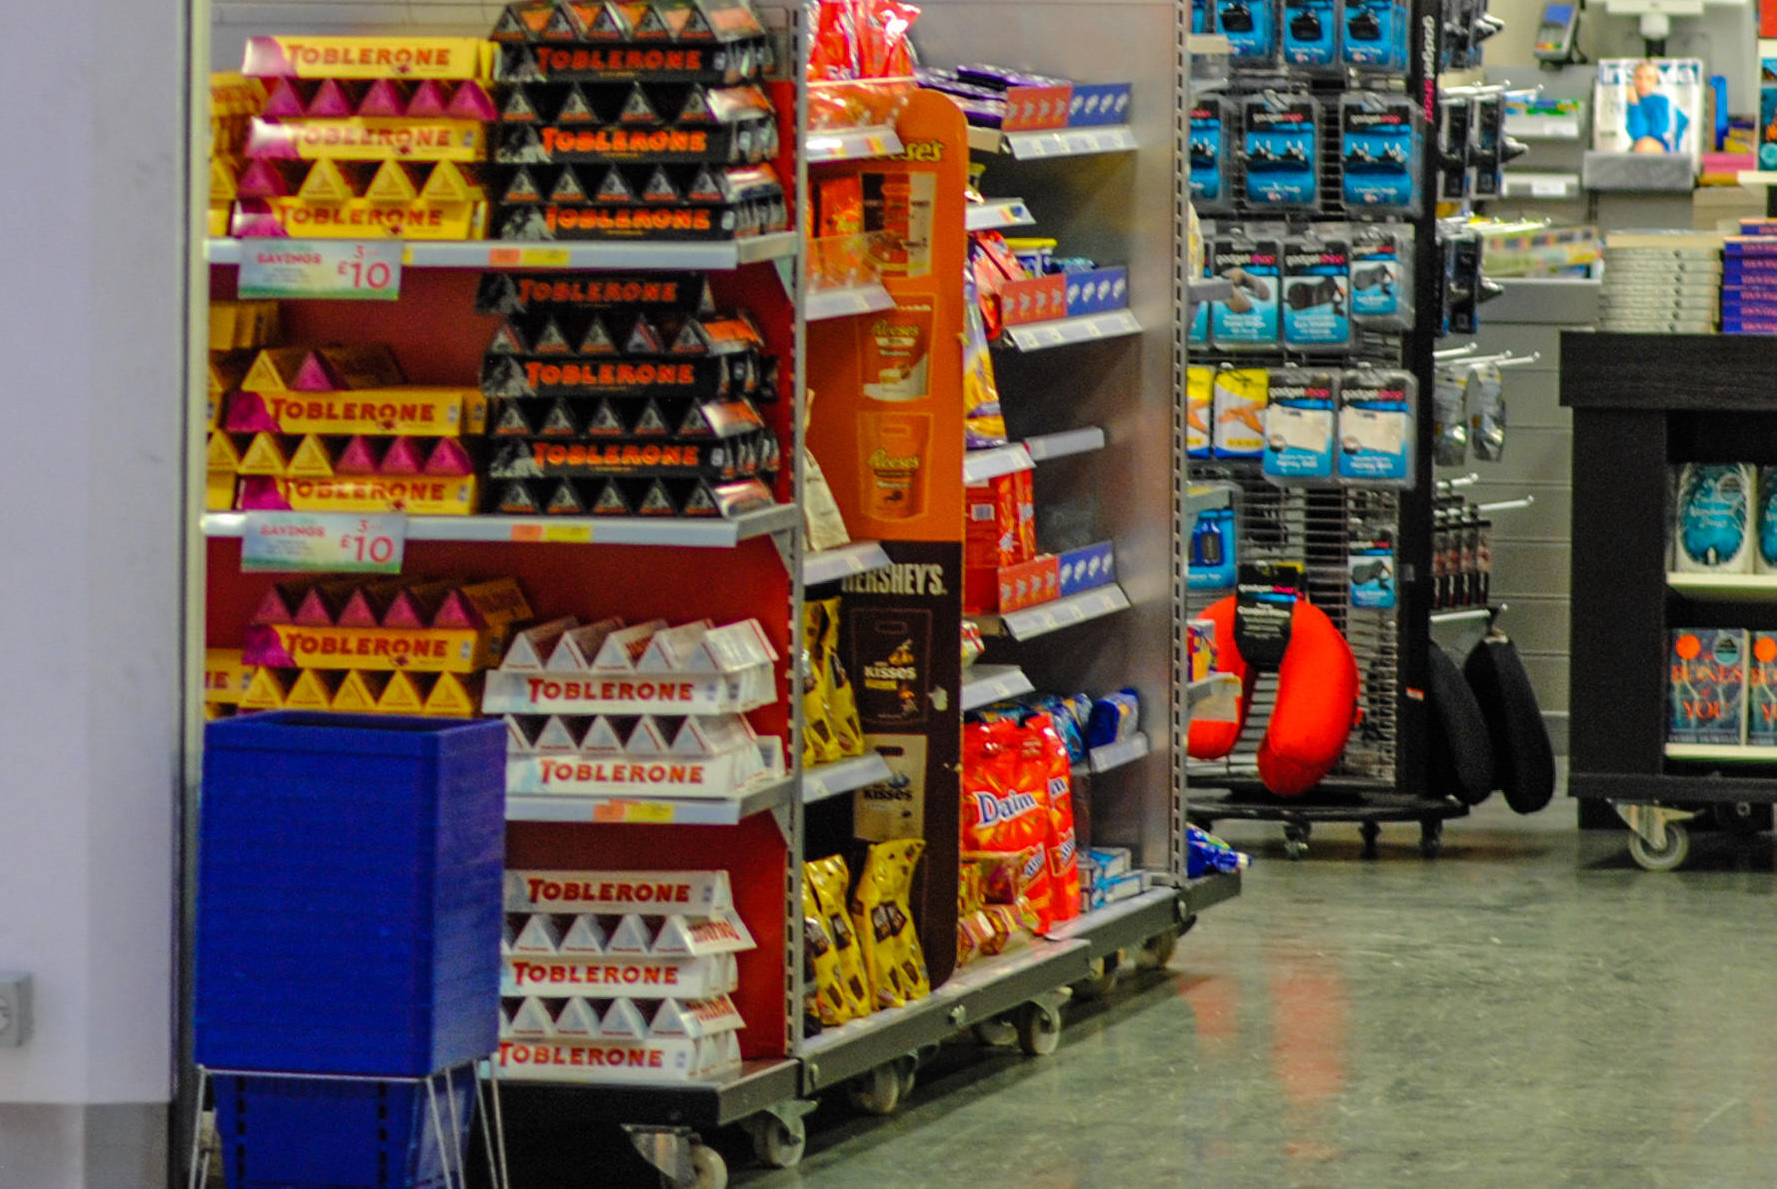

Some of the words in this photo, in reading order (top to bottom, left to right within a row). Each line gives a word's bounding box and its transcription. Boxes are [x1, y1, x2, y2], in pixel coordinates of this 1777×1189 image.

[287, 44, 452, 68] TOBLERONE
[537, 46, 702, 71] TOBLERONE
[541, 127, 707, 153] TOBLERONE
[280, 204, 444, 229] TOBLERONE
[545, 204, 711, 231] TOBLERONE
[256, 252, 322, 266] SAVINGS
[336, 261, 390, 291] £10
[518, 276, 677, 304] TOBLERONE
[525, 361, 695, 388] TOBLERONE
[271, 396, 436, 423] TOBLERONE
[532, 440, 699, 467] TOBLERONE
[260, 525, 326, 539] SAVINGS
[340, 534, 395, 565] £10
[286, 632, 449, 659] TOBLERONE
[527, 677, 695, 703] TOBLERONE
[539, 757, 704, 786] TOBLERONE
[973, 790, 1040, 830] Daim
[526, 878, 691, 903] TOBLERONE
[512, 961, 679, 987] TOBLERONE
[498, 1040, 664, 1069] TOBLERONE
